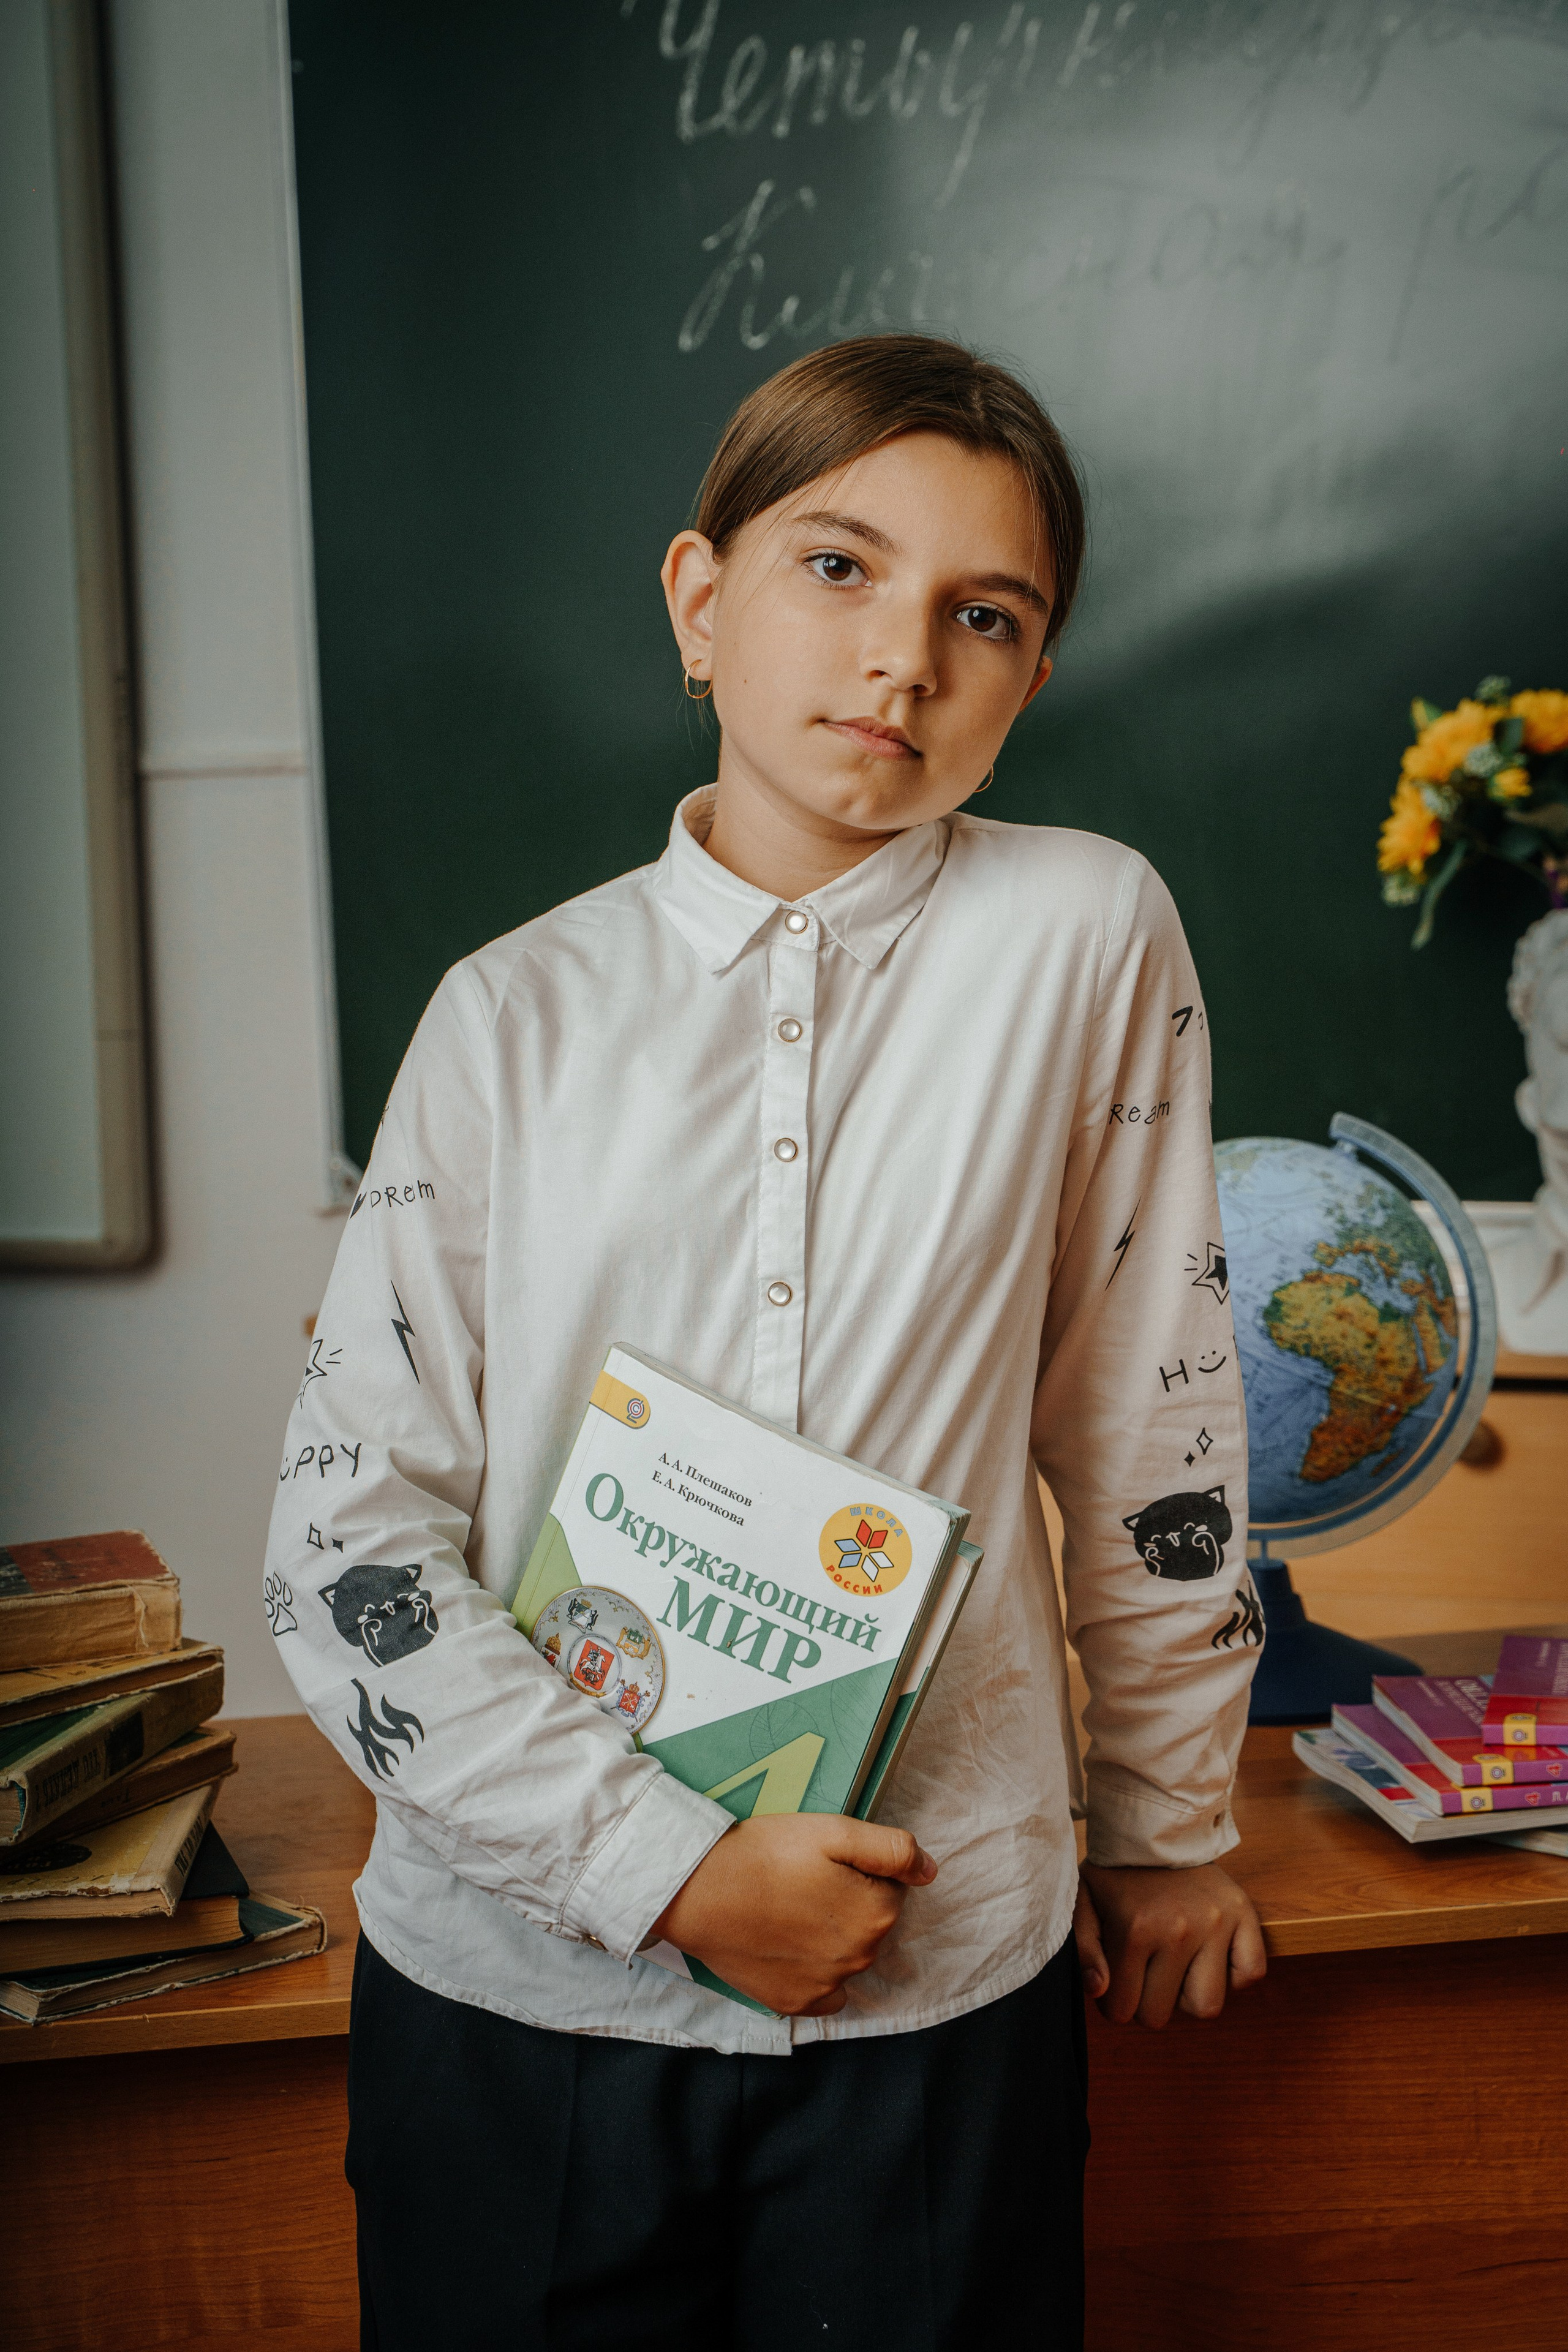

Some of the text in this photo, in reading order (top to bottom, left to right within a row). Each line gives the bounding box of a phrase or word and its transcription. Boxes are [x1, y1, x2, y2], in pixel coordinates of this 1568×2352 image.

[677, 1483, 745, 1526] Крючкова
[685, 1465, 753, 1507] Плешаков
[850, 1506, 903, 1537] ШКОЛА
[585, 1472, 881, 1652] Окружающий
[826, 1564, 883, 1594] РОССИИ
[656, 1575, 822, 1684] МИР
